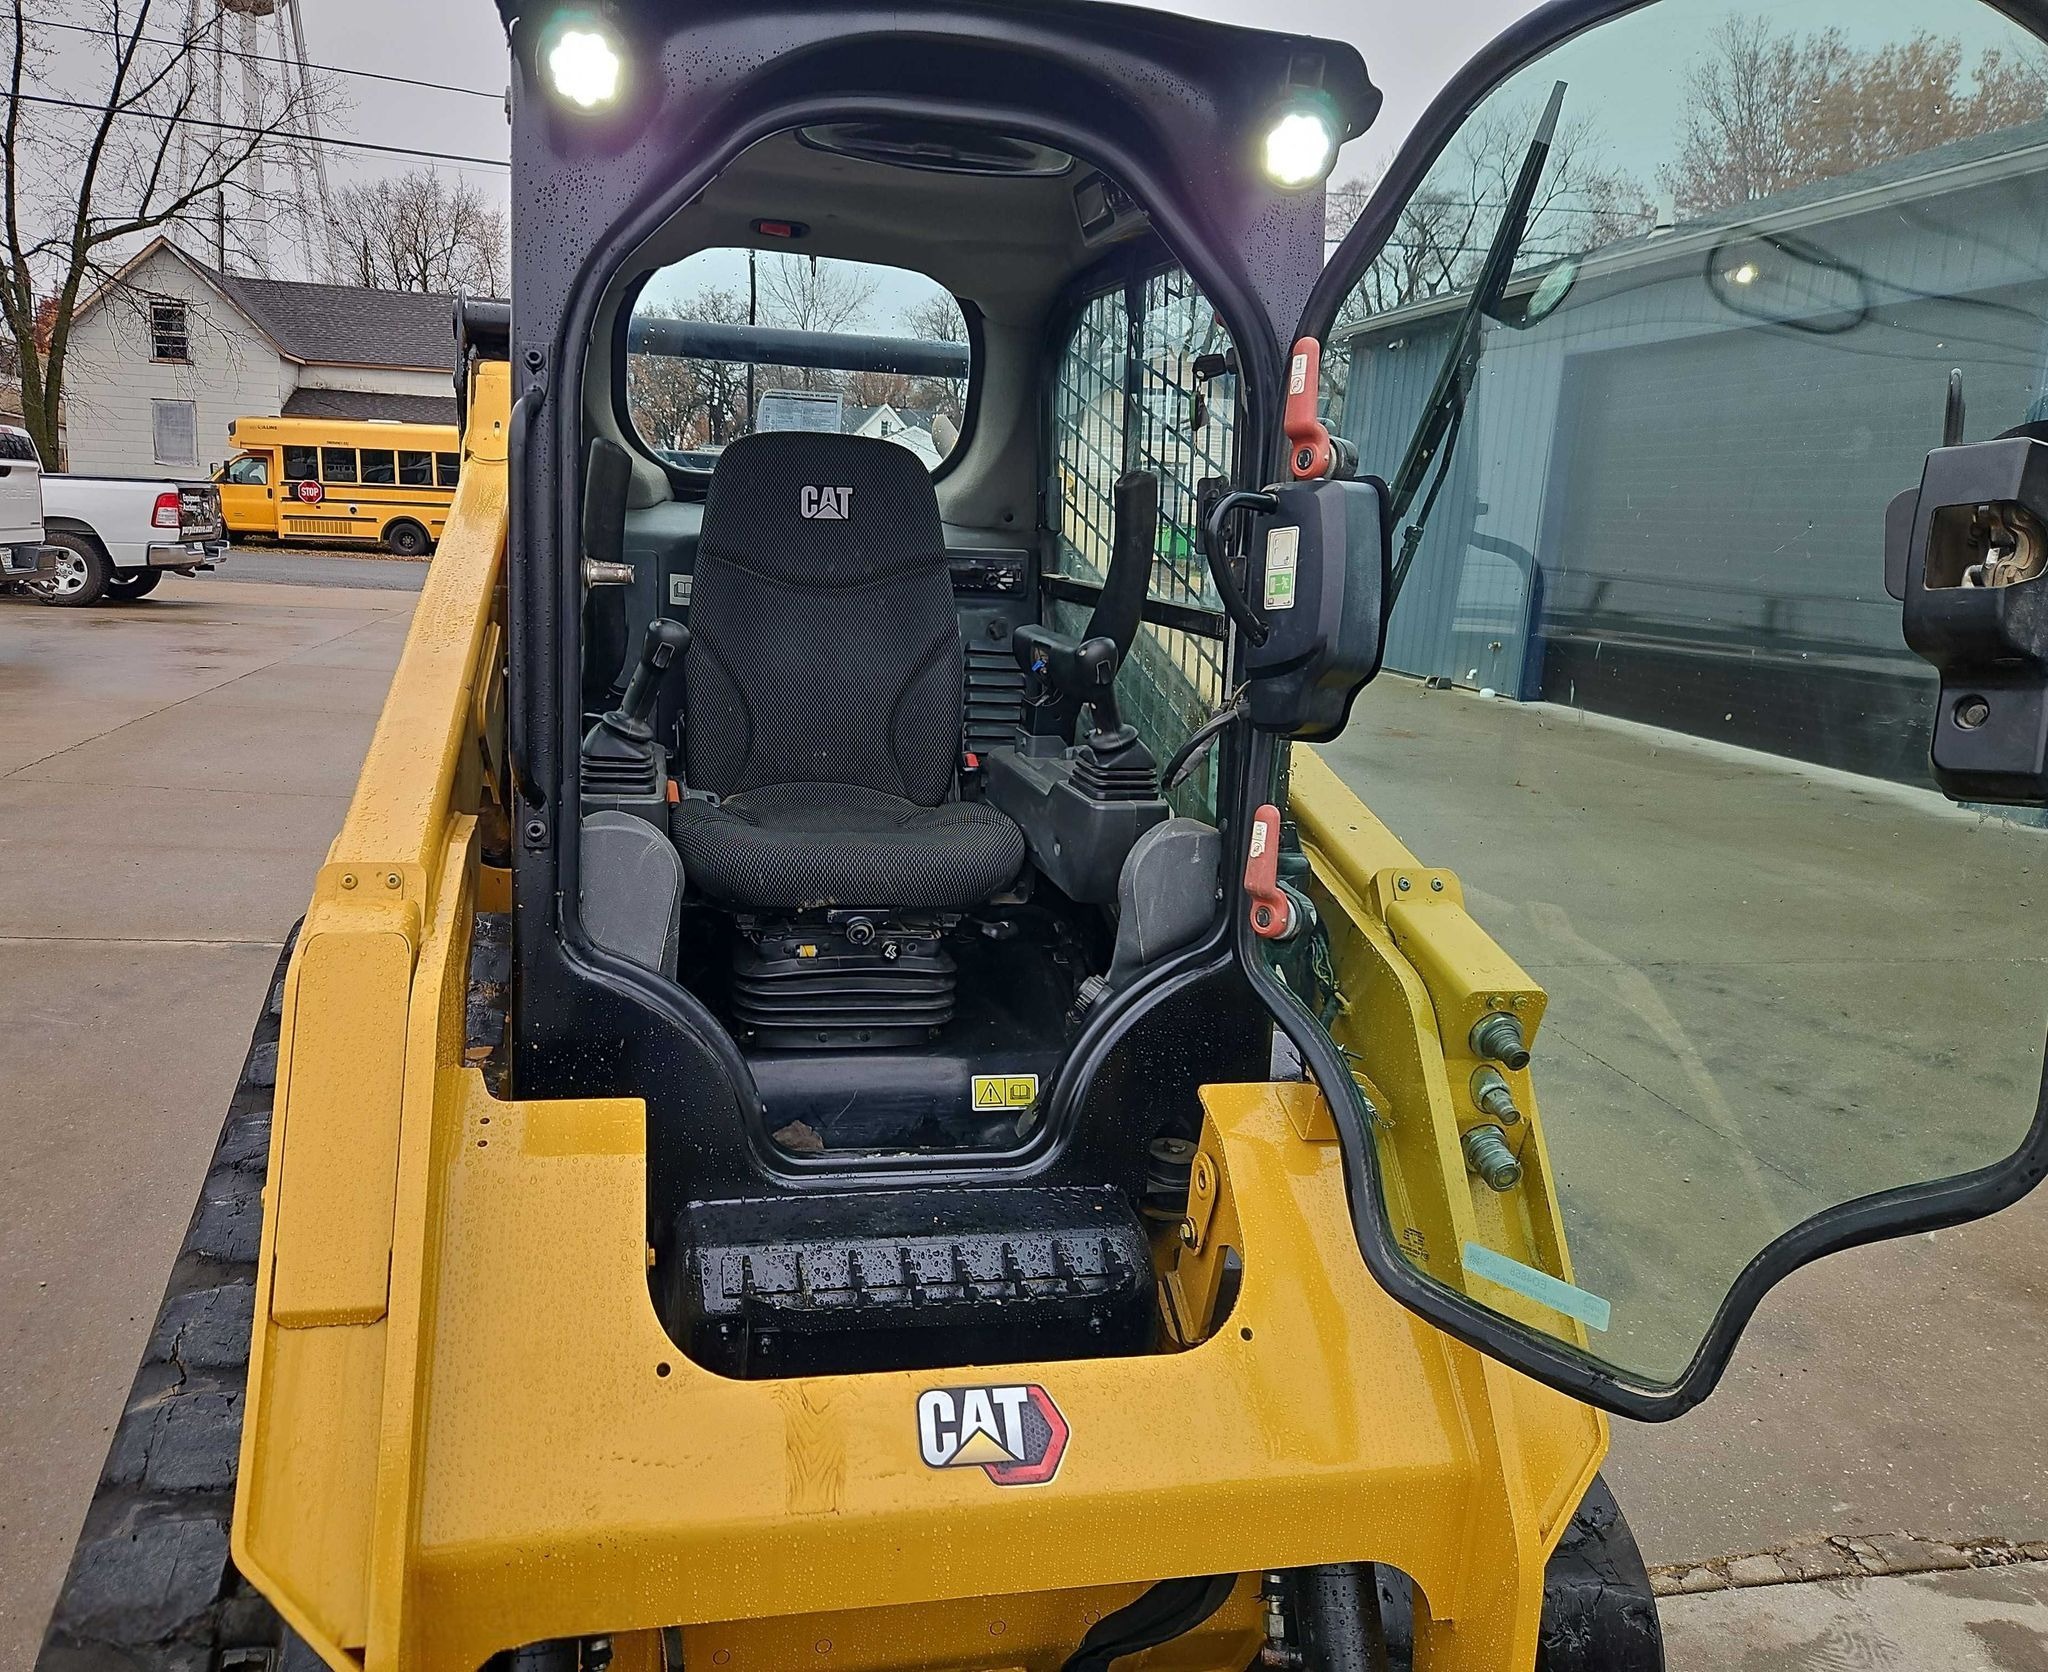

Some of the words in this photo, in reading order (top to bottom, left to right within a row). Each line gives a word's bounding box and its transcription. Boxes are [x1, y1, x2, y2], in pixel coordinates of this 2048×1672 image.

[300, 487, 319, 497] STOP
[801, 485, 853, 519] CAT
[918, 1386, 1029, 1466] CAT
